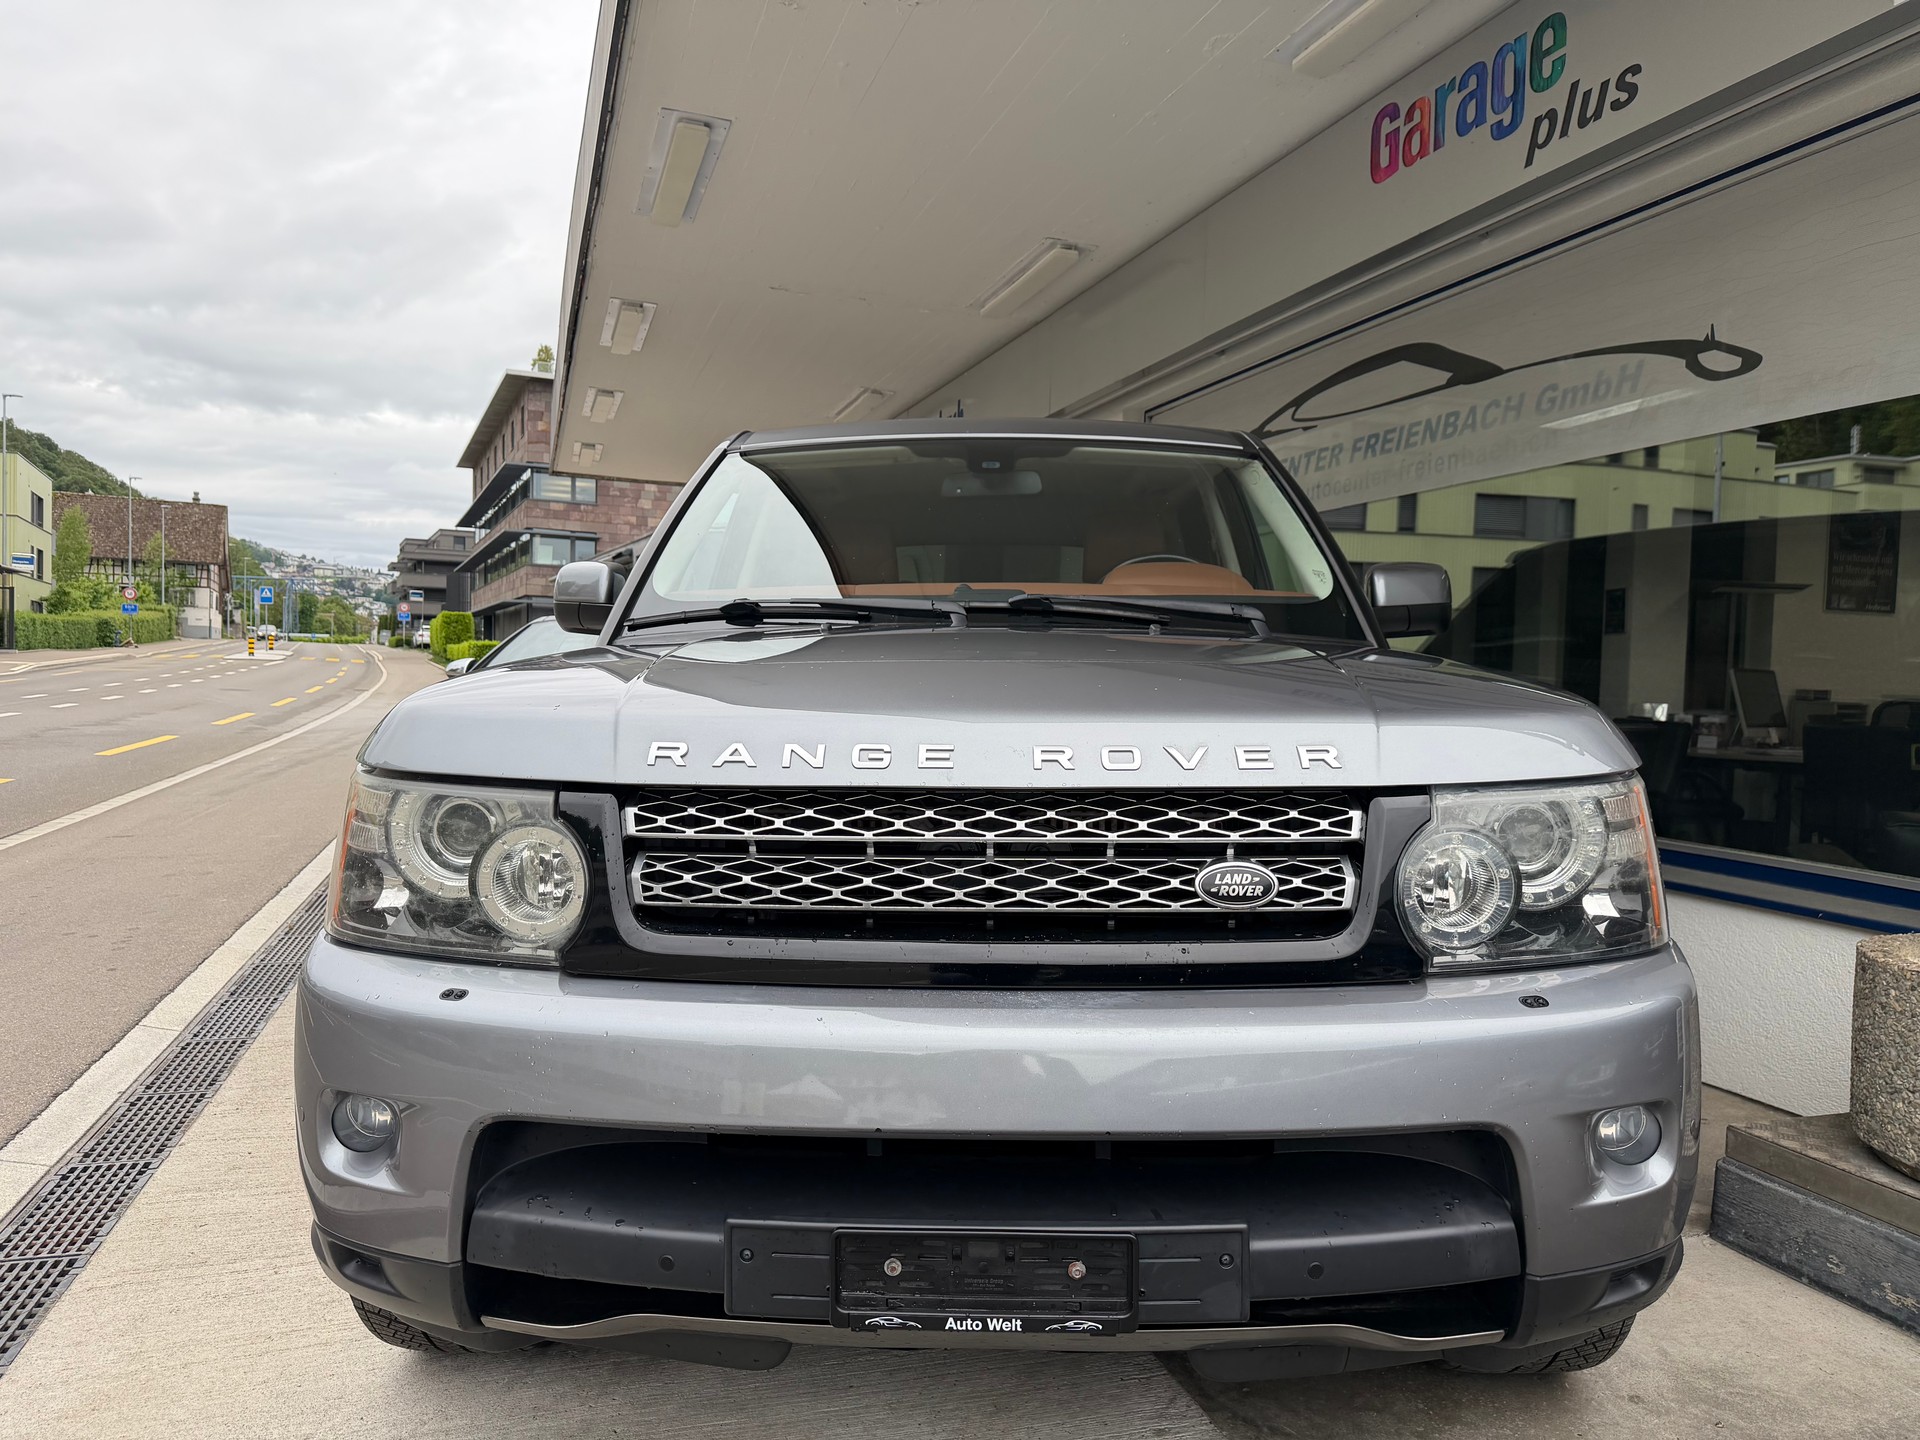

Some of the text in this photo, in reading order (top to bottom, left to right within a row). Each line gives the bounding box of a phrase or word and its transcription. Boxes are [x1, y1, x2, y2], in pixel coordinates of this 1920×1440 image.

[1370, 11, 1567, 185] Garage
[1524, 63, 1642, 169] plus
[1279, 358, 1646, 478] NTER FREIENBACH GmbH
[647, 741, 1343, 771] RANGE ROVER
[1214, 873, 1252, 885] LAND
[1218, 885, 1264, 897] ROVER
[945, 1317, 1022, 1332] Auto Welt
